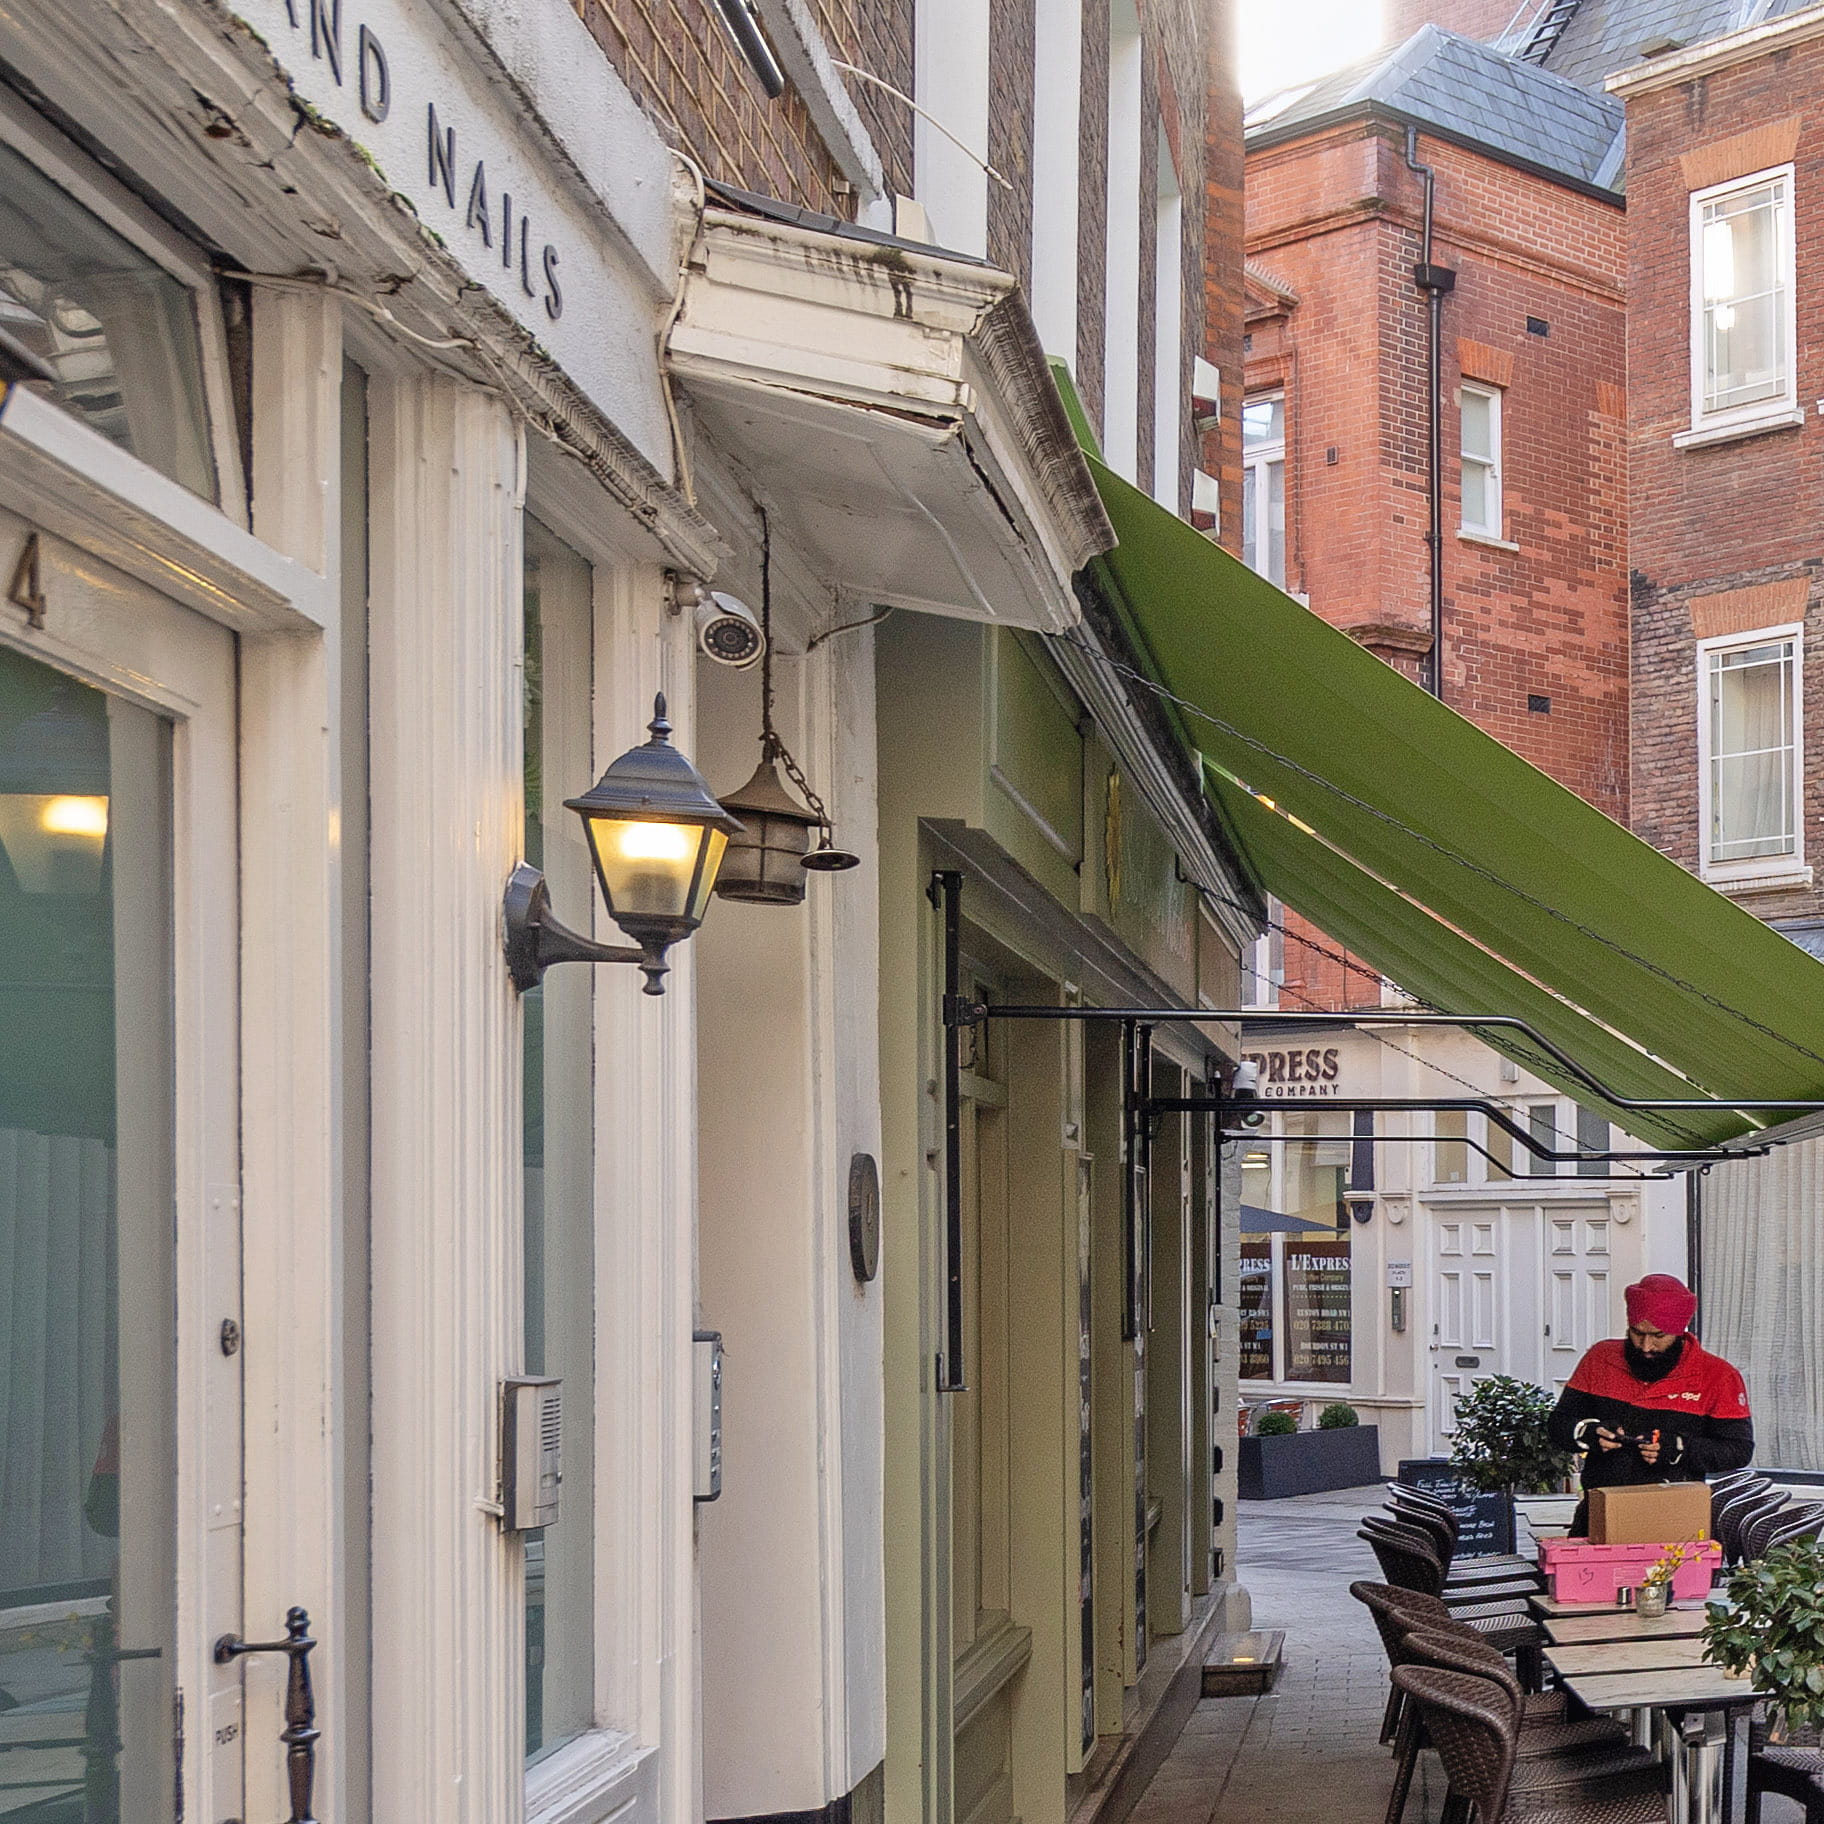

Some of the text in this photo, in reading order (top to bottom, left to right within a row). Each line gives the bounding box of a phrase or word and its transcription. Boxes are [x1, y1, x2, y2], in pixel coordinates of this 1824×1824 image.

[427, 99, 564, 321] NAILS
[7, 531, 47, 631] 4
[1241, 1047, 1340, 1083] PRESS
[1264, 1083, 1340, 1098] COMPANY
[1681, 1391, 1702, 1401] dpd
[215, 1722, 239, 1745] PUSH
